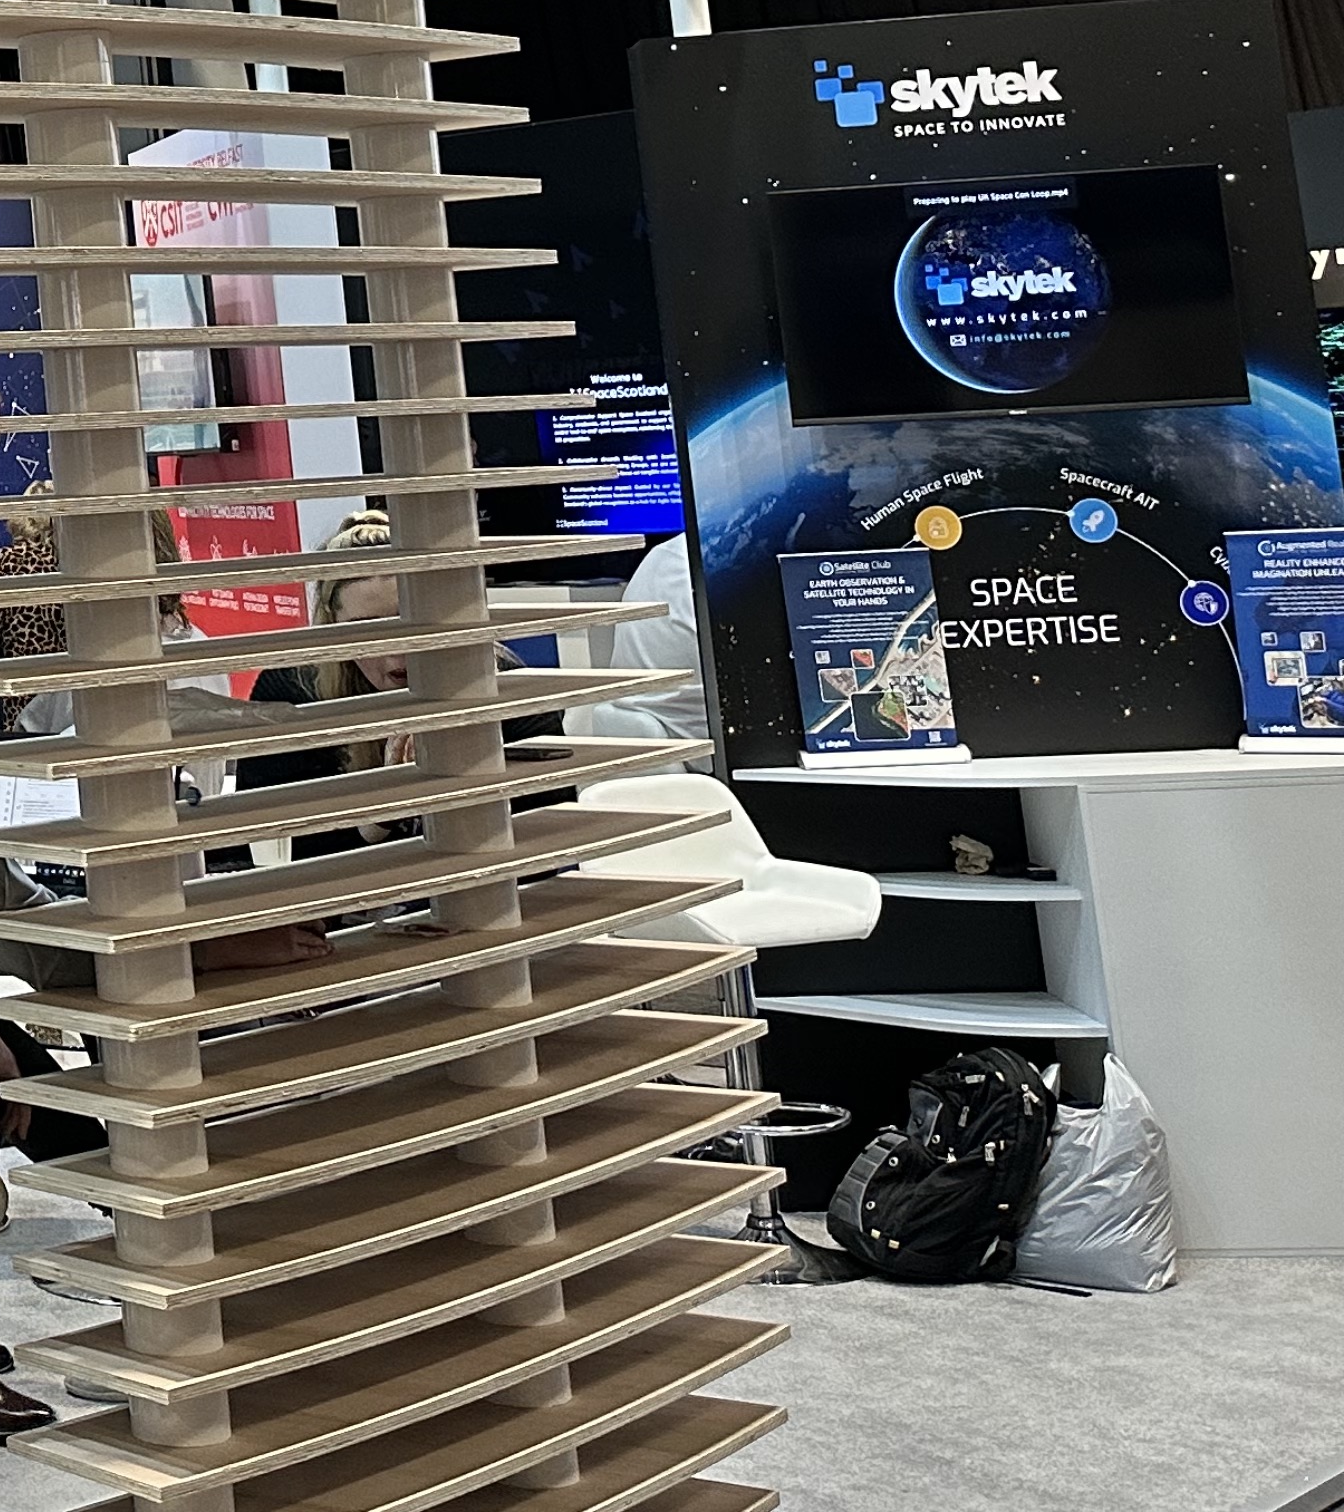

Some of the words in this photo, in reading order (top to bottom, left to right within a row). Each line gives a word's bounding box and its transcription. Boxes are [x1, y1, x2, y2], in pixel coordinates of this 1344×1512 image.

[890, 60, 1063, 118] skytek
[894, 122, 946, 138] SPACE
[950, 119, 974, 134] TO
[979, 113, 1066, 131] INNOVATE
[971, 266, 1077, 301] skytek
[860, 498, 905, 531] Human
[903, 480, 943, 503] Space
[943, 467, 985, 487] Flight
[1060, 467, 1135, 500] Spacecraft
[1133, 491, 1160, 511] AIT
[970, 575, 1079, 607] SPACE
[940, 614, 1121, 649] EXPERTISE
